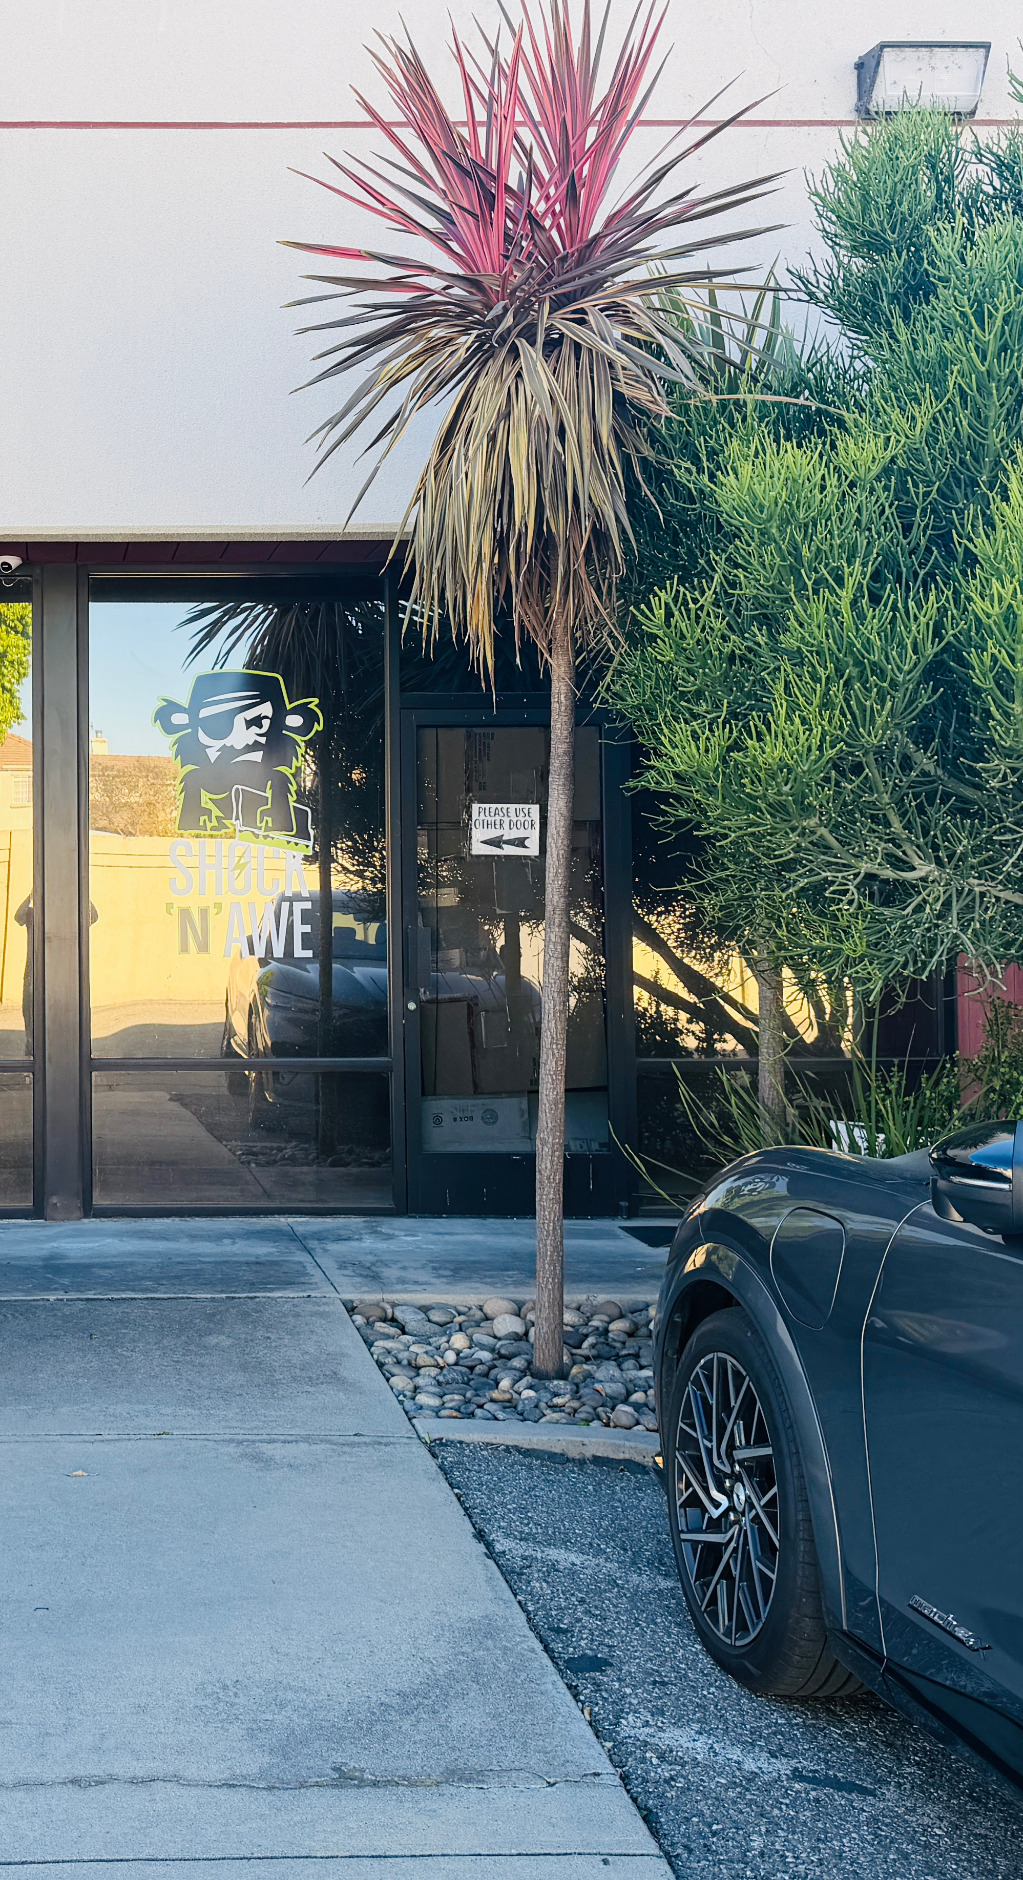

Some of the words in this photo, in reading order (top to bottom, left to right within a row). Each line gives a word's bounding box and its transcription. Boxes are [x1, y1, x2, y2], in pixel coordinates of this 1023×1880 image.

[473, 819, 505, 830] OTHER
[508, 819, 536, 831] DOOR
[478, 806, 511, 818] PLEASE
[515, 807, 532, 818] USE
[168, 839, 311, 898] SHOCK
[223, 901, 314, 958] AWE
